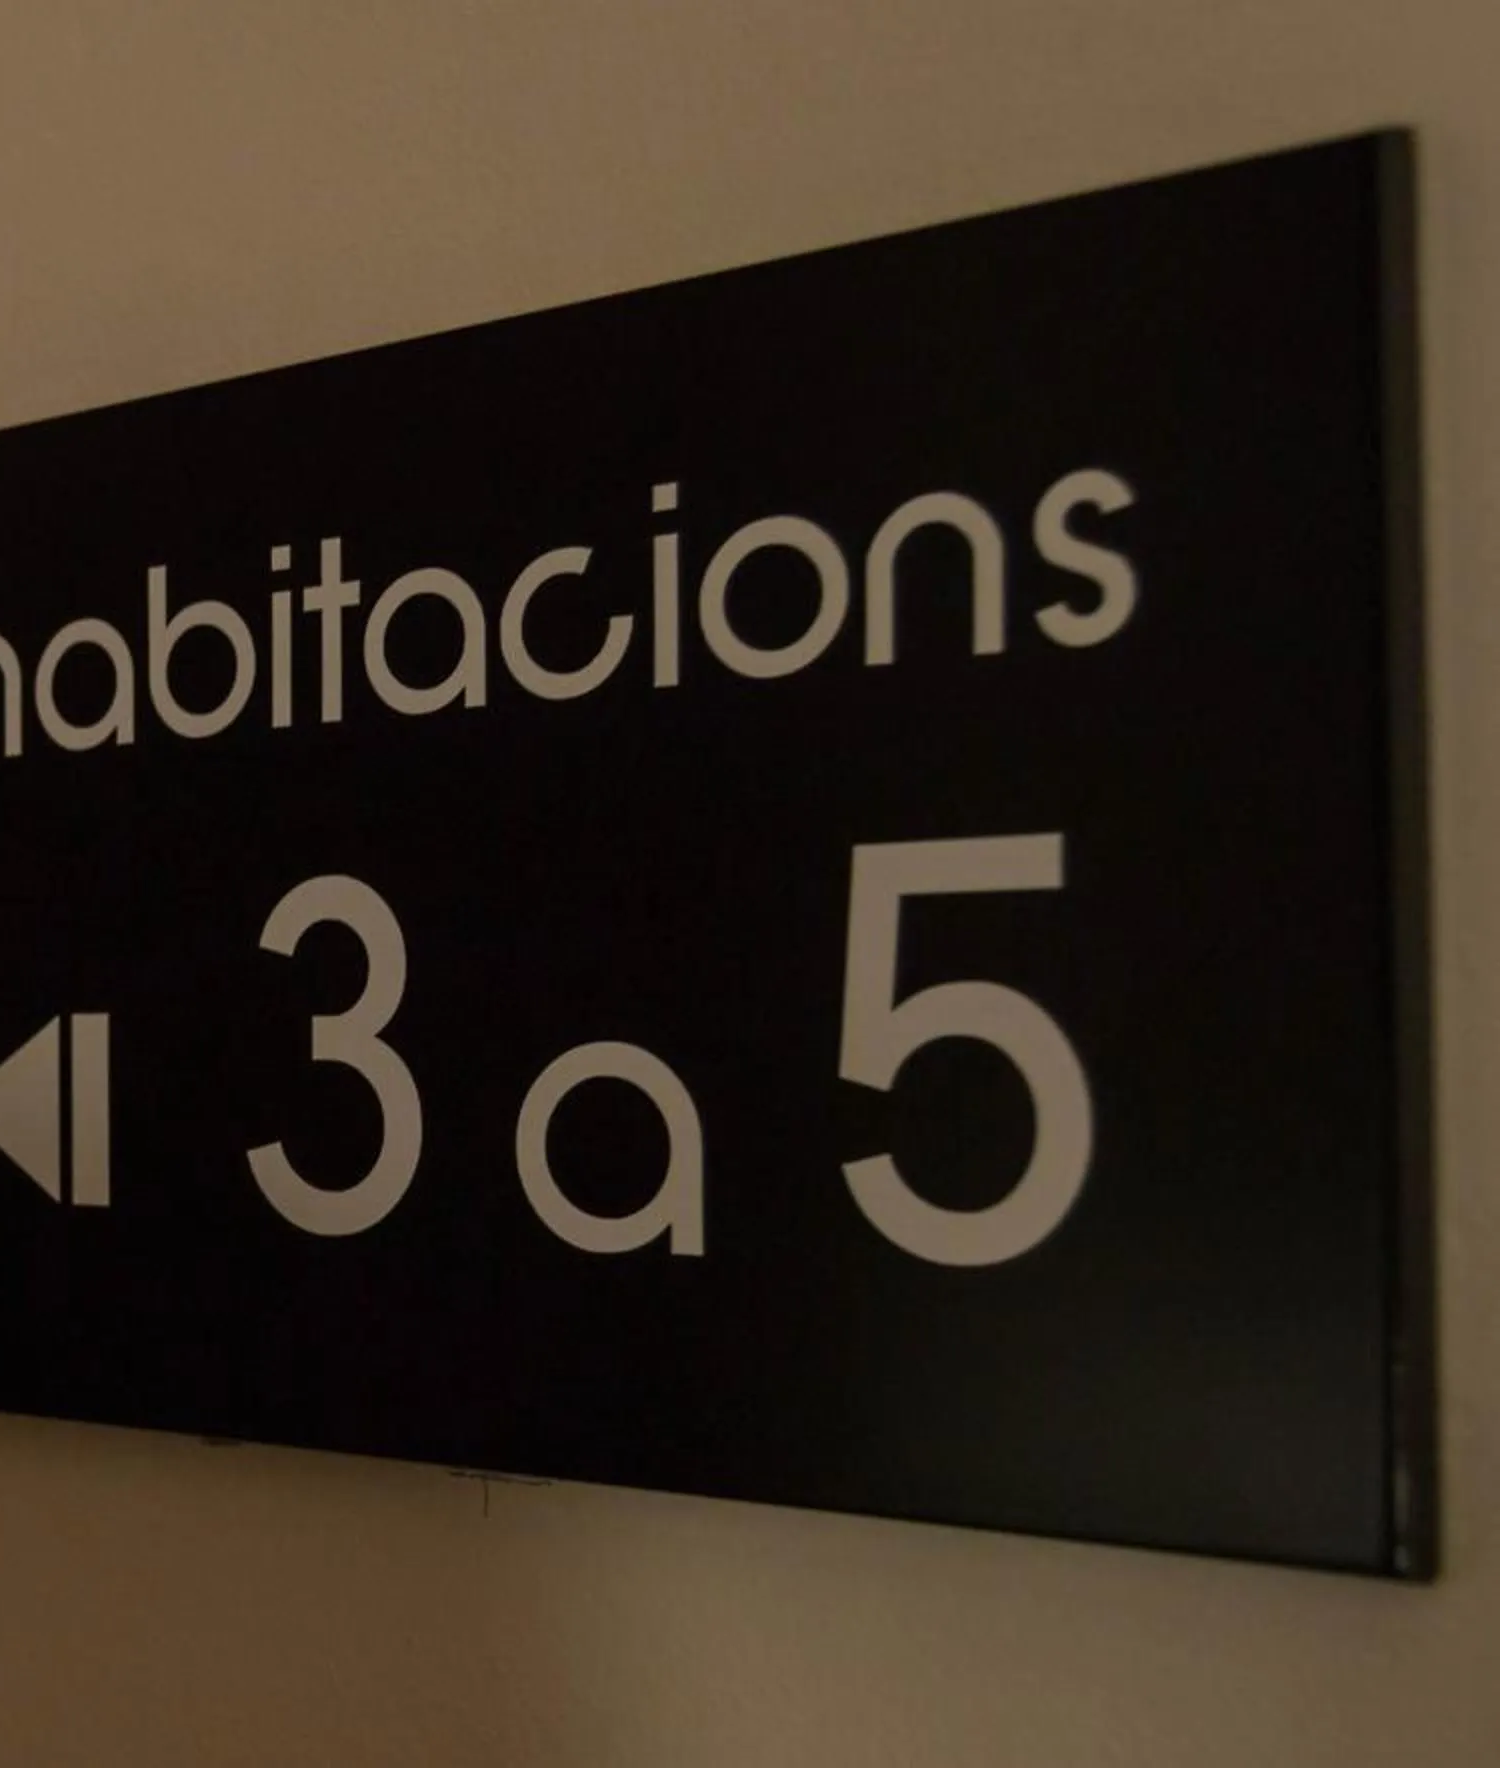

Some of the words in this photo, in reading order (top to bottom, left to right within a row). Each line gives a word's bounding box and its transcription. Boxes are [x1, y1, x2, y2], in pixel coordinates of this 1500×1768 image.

[247, 875, 423, 1236] 3
[515, 1040, 705, 1257] a
[838, 832, 1092, 1267] 5
